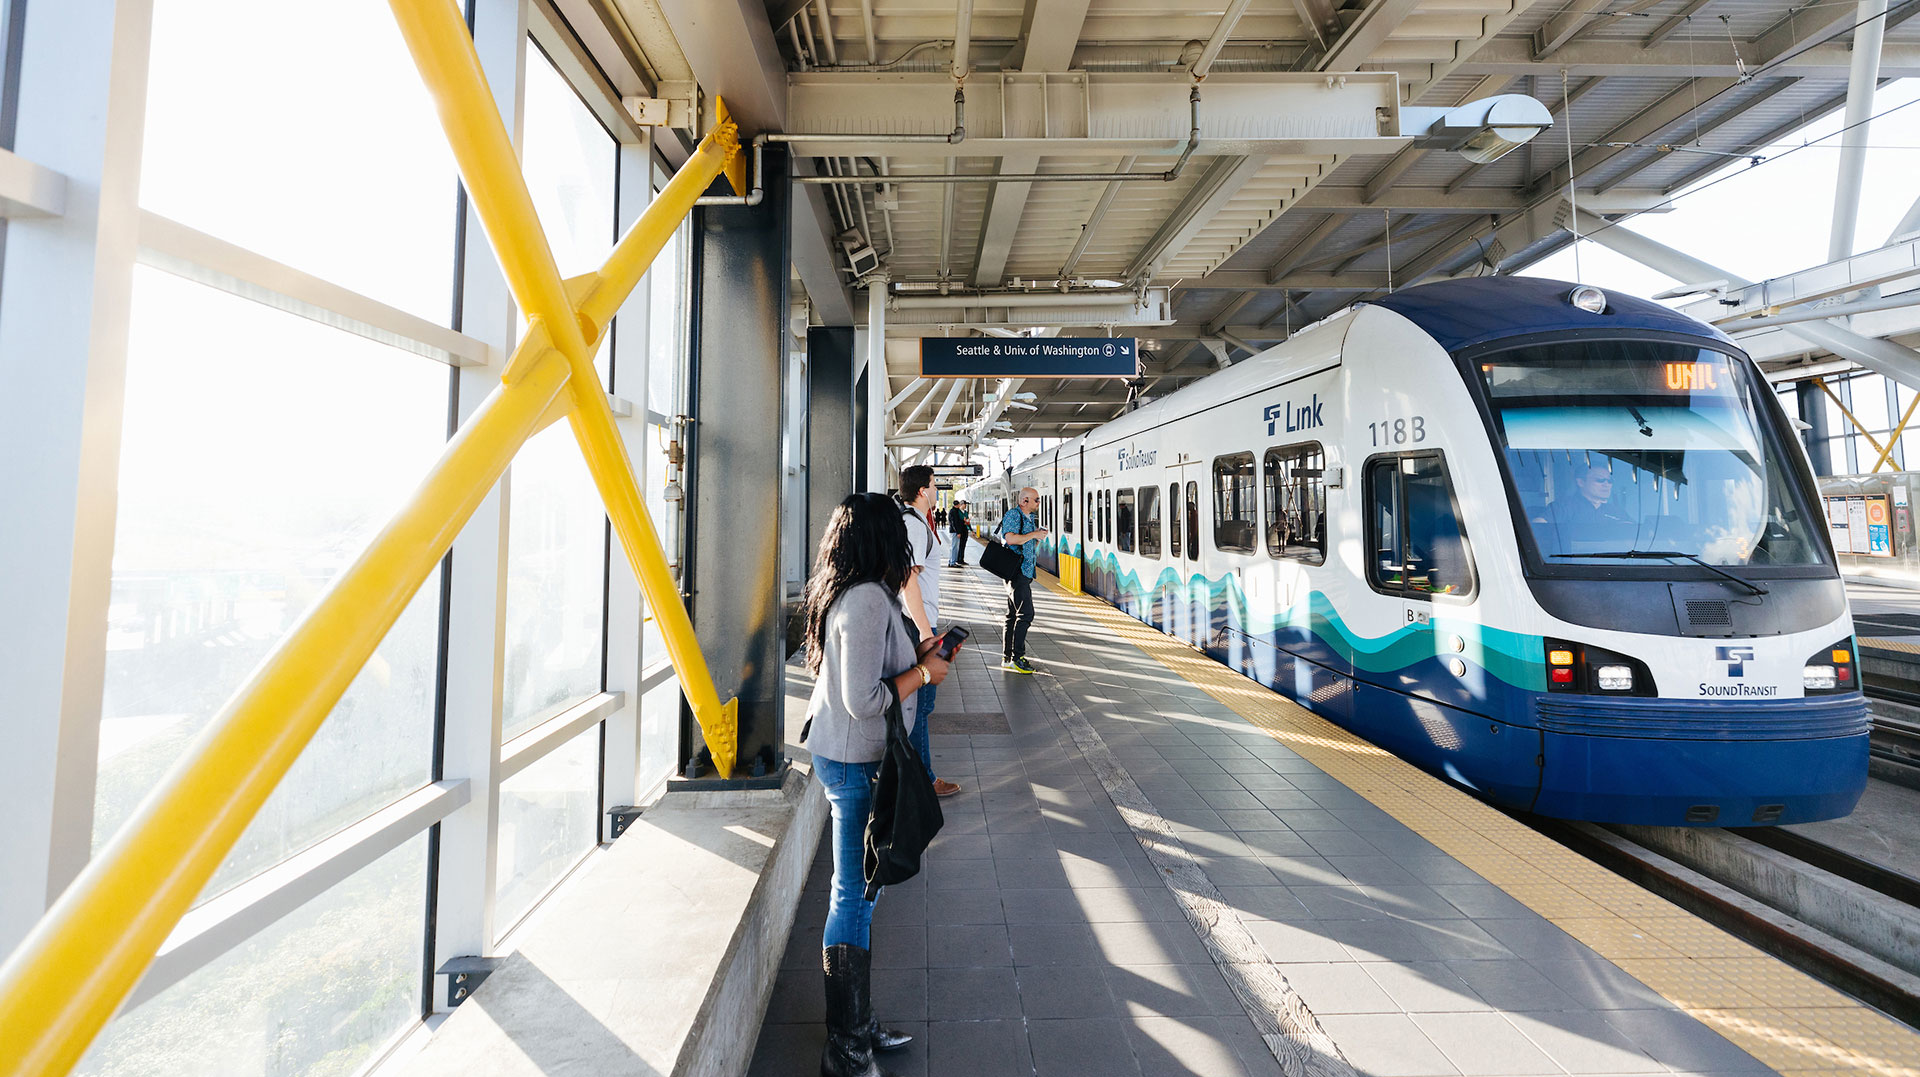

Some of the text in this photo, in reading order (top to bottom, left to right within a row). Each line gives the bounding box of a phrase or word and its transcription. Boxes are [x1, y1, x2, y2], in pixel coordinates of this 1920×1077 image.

[956, 344, 1100, 358] Seattle & Univ. of Washington
[1286, 393, 1324, 433] Link
[1368, 416, 1426, 447] 118B
[1407, 609, 1414, 622] B
